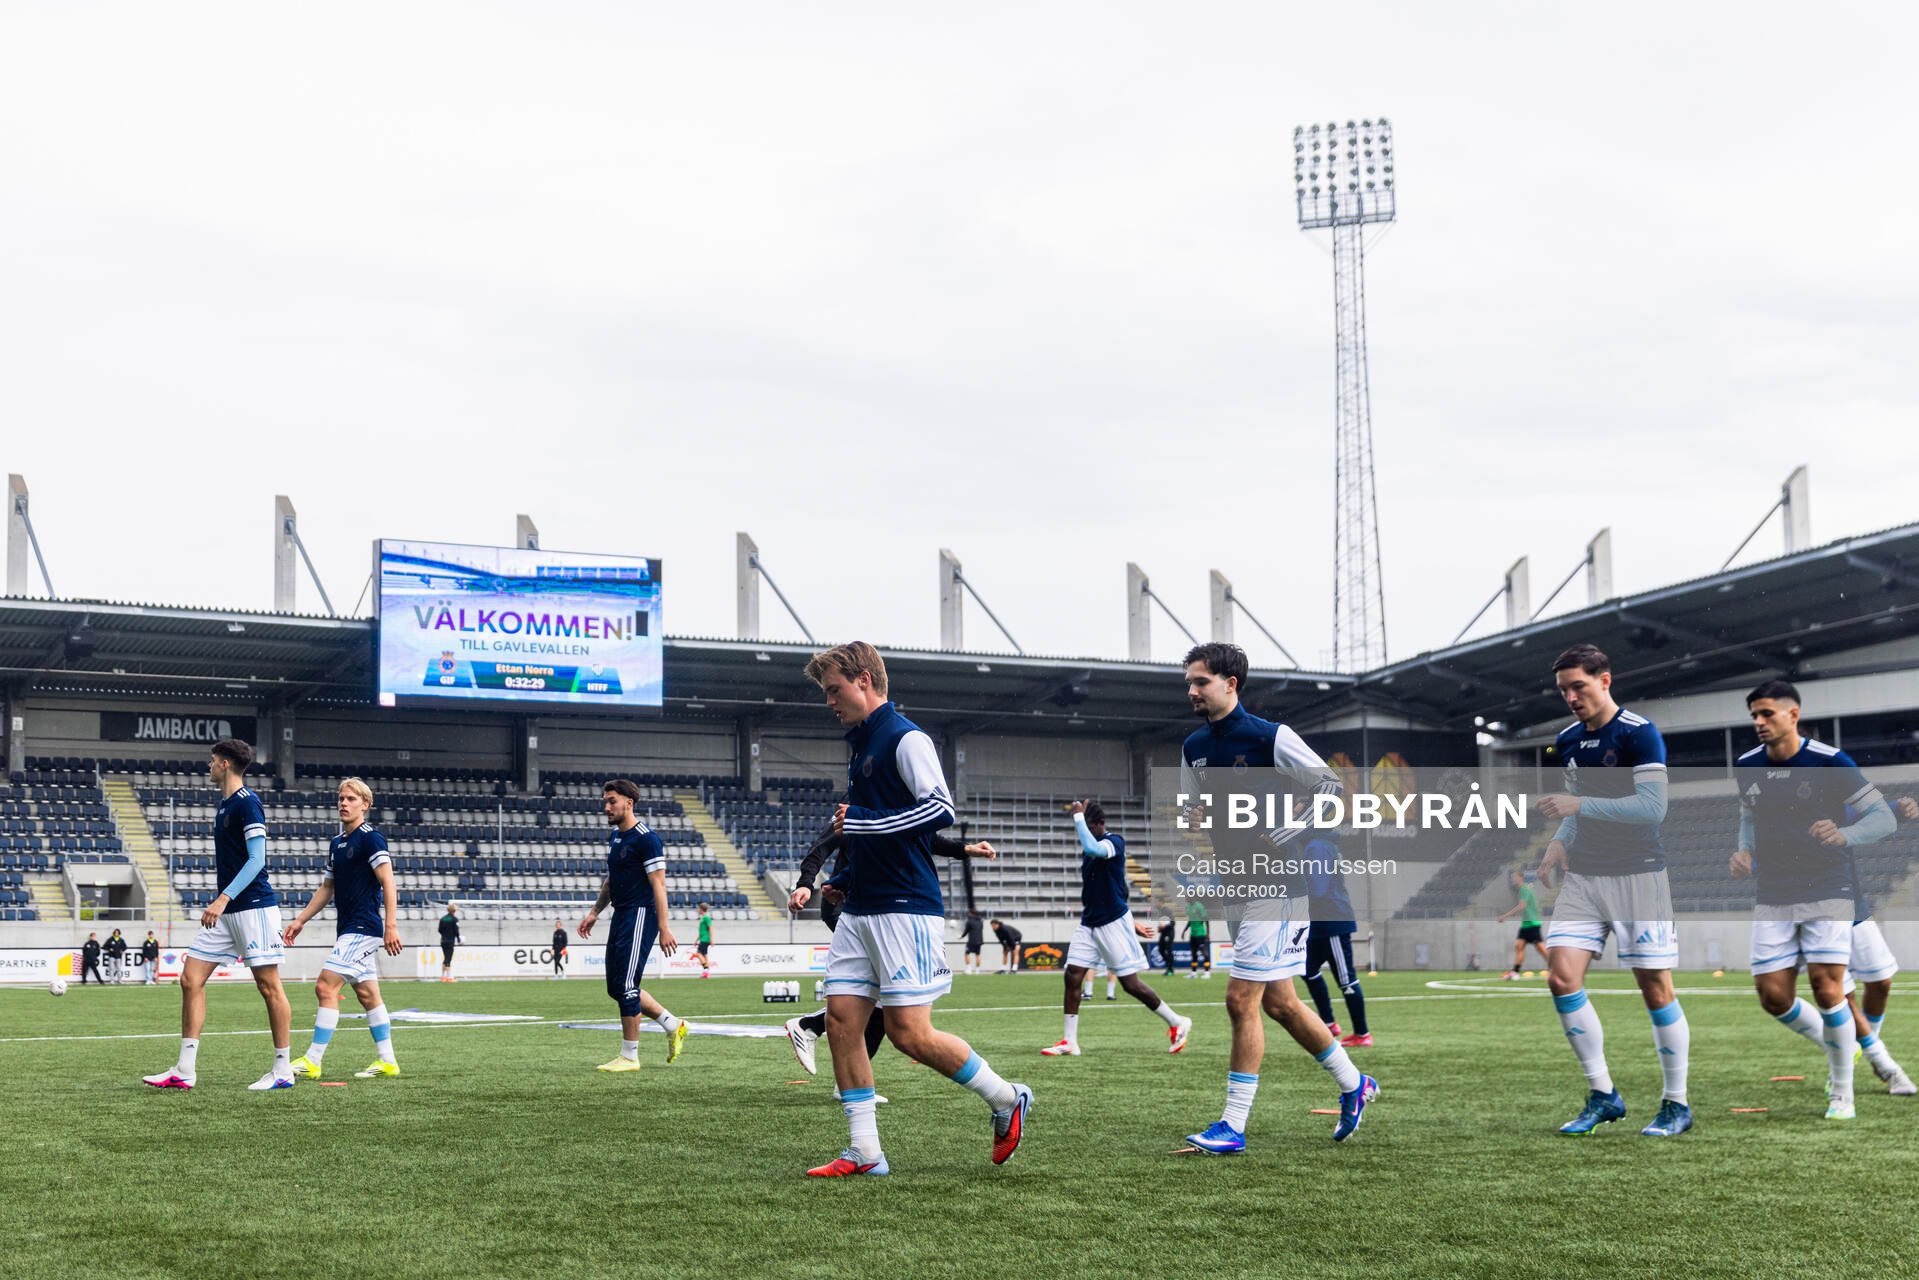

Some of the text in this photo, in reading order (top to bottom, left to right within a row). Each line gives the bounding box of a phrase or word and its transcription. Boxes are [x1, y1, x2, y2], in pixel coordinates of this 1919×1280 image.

[413, 600, 632, 641] VÄLKOMMEN!
[460, 638, 590, 656] TILL GAVLEVALLEN
[496, 663, 523, 674] Ettan
[504, 677, 546, 689] 0:32:29
[134, 717, 217, 740] JAMBACK
[754, 954, 795, 963] SANDVIK
